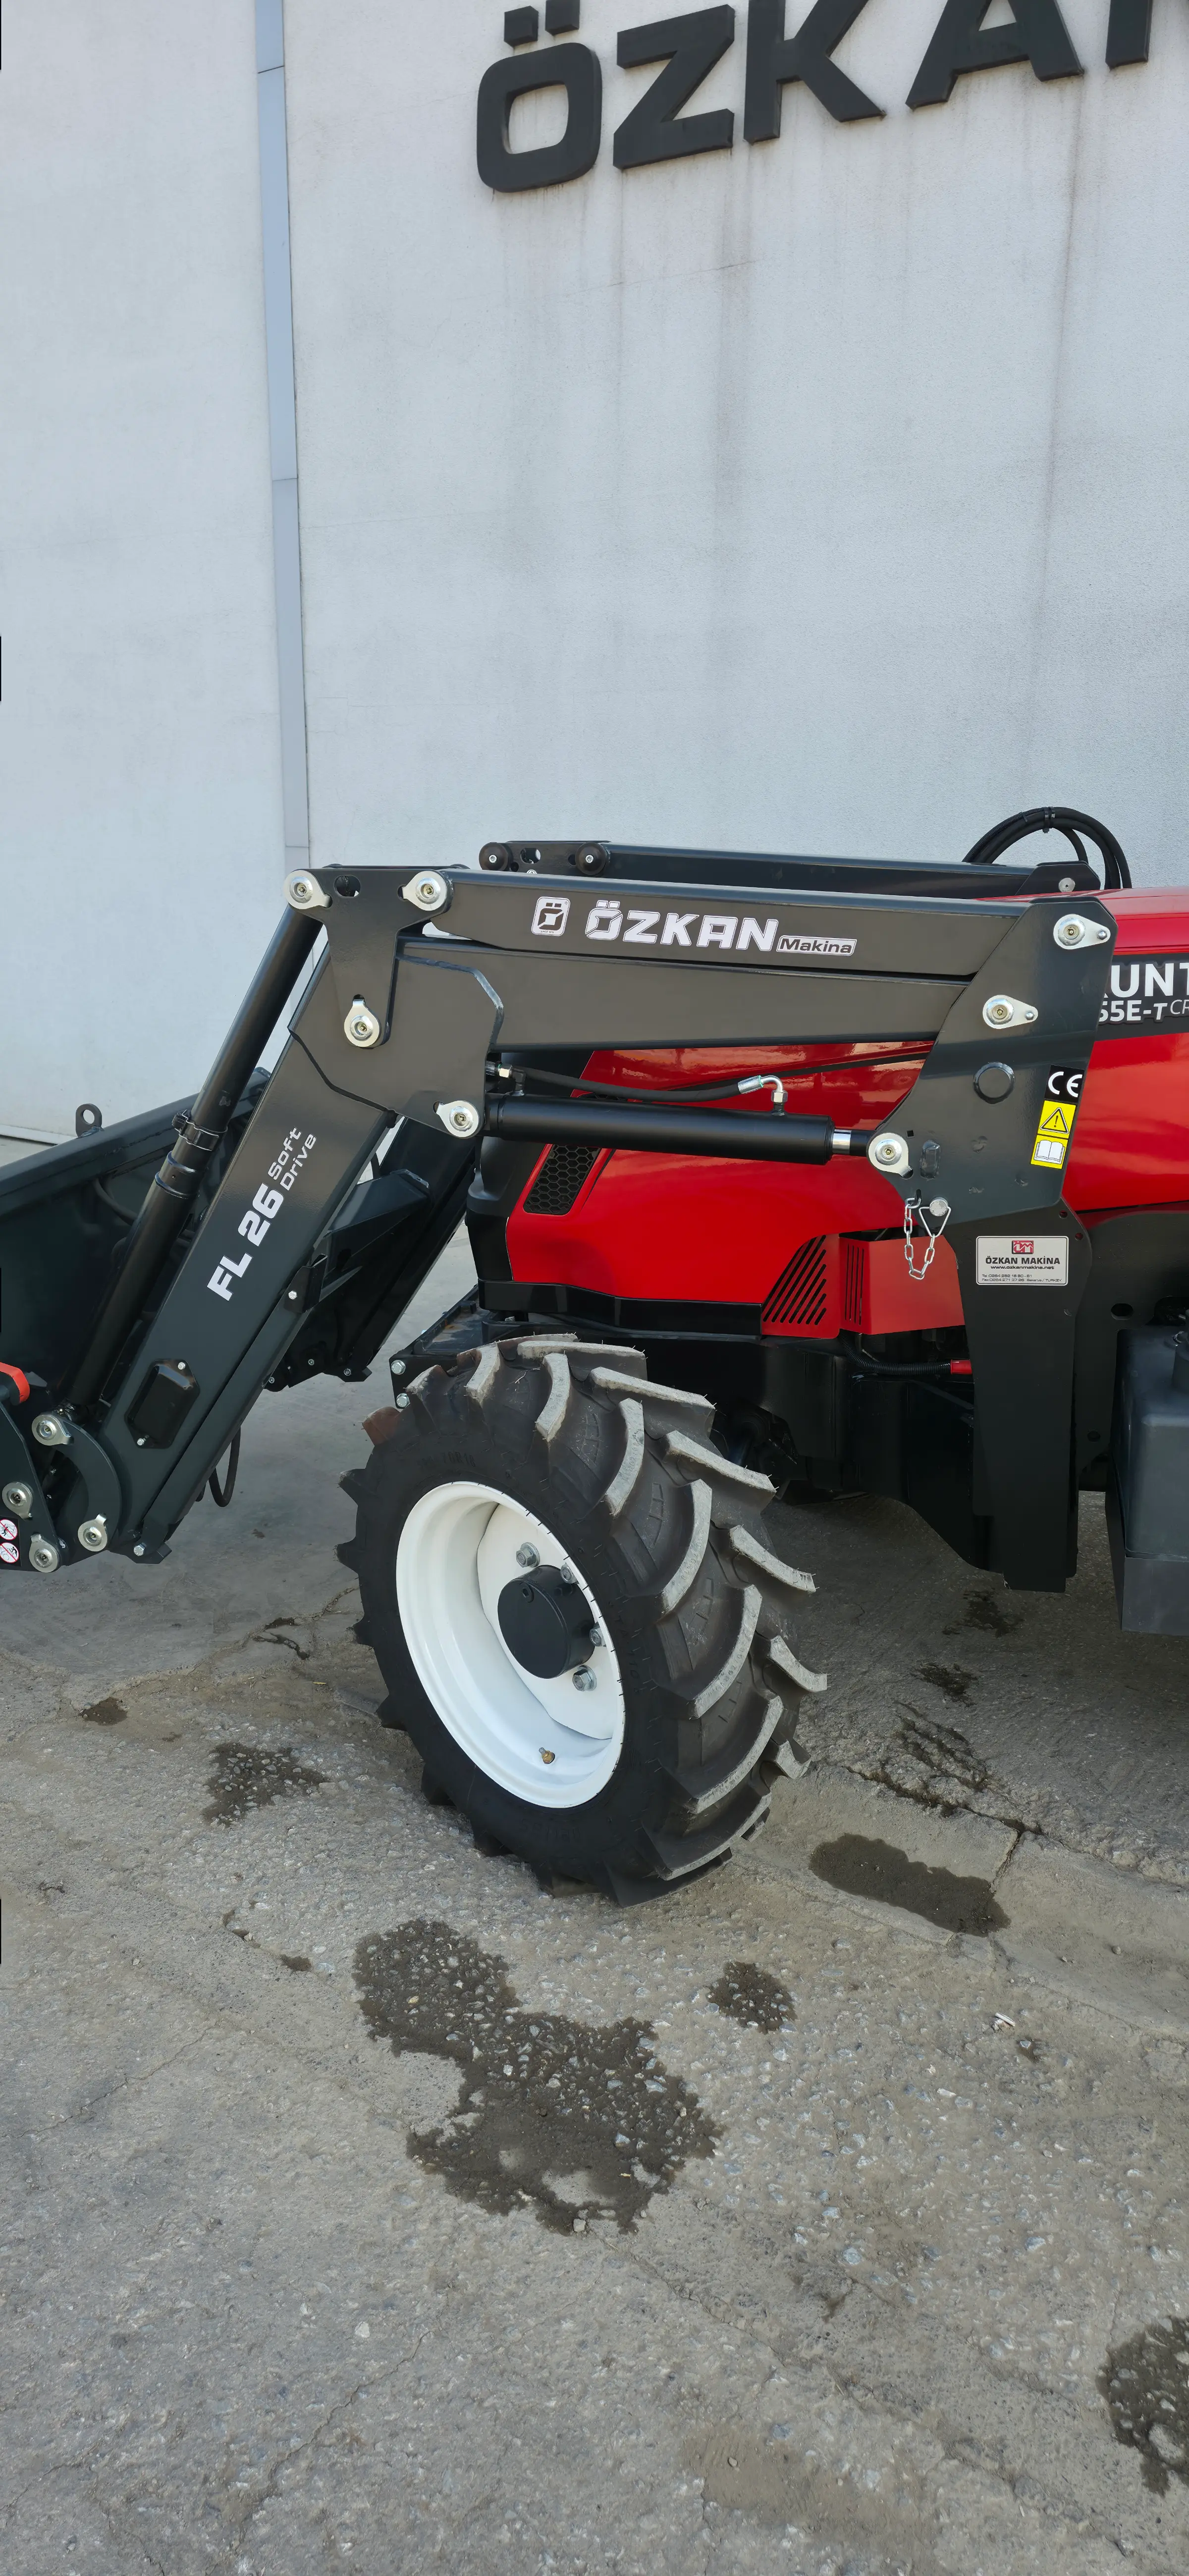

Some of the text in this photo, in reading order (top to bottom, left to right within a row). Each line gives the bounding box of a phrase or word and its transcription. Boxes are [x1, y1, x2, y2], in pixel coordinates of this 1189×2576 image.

[585, 900, 852, 954] ÖZKAN Makina
[1048, 1071, 1083, 1098] CE
[268, 1127, 302, 1181] Soft
[279, 1133, 317, 1191] Drive
[207, 1182, 284, 1301] FL 26
[985, 1255, 1060, 1265] ÖZKAN MAKİNA
